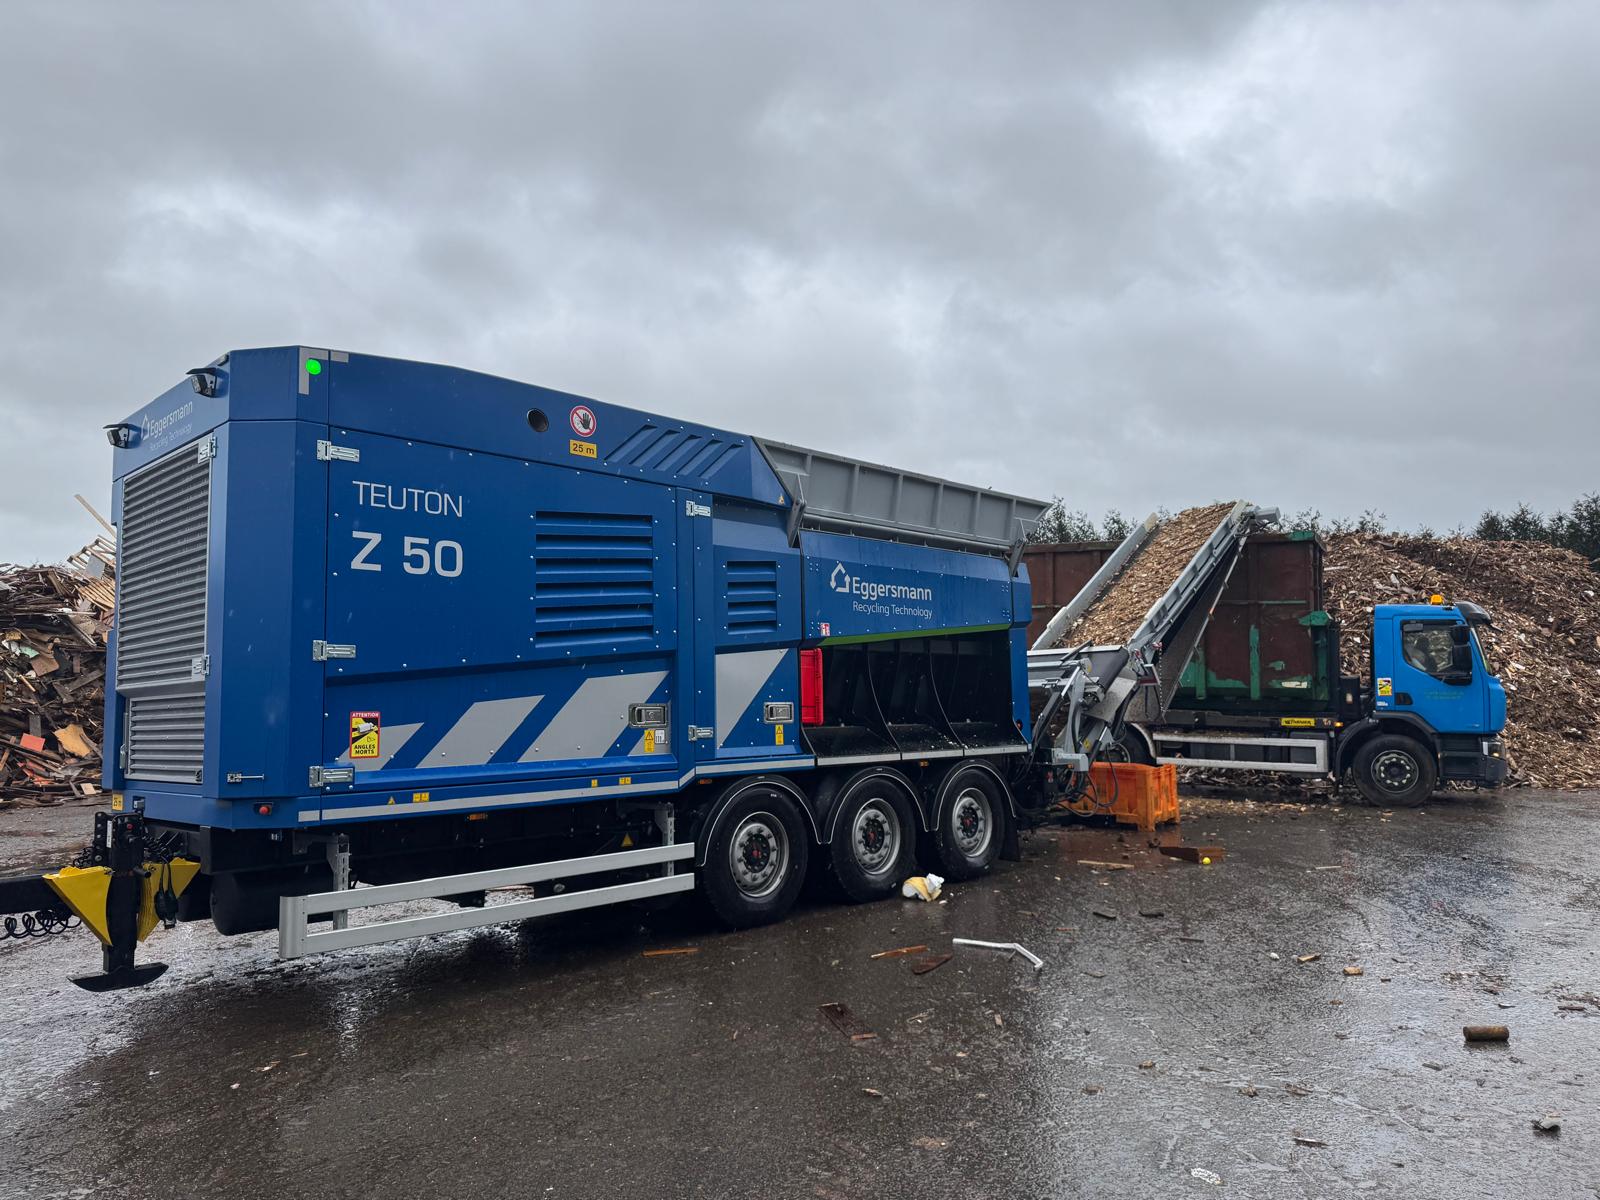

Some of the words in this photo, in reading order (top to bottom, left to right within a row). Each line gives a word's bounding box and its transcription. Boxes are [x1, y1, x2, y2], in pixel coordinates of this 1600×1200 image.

[150, 400, 193, 439] Eggersmann
[572, 443, 584, 453] 25
[586, 447, 595, 455] m
[352, 480, 463, 518] TEUTON
[351, 530, 382, 572] Z
[403, 536, 464, 578] 50
[852, 576, 932, 601] Eggersmann
[853, 601, 890, 616] Recycling
[891, 604, 933, 619] Technology
